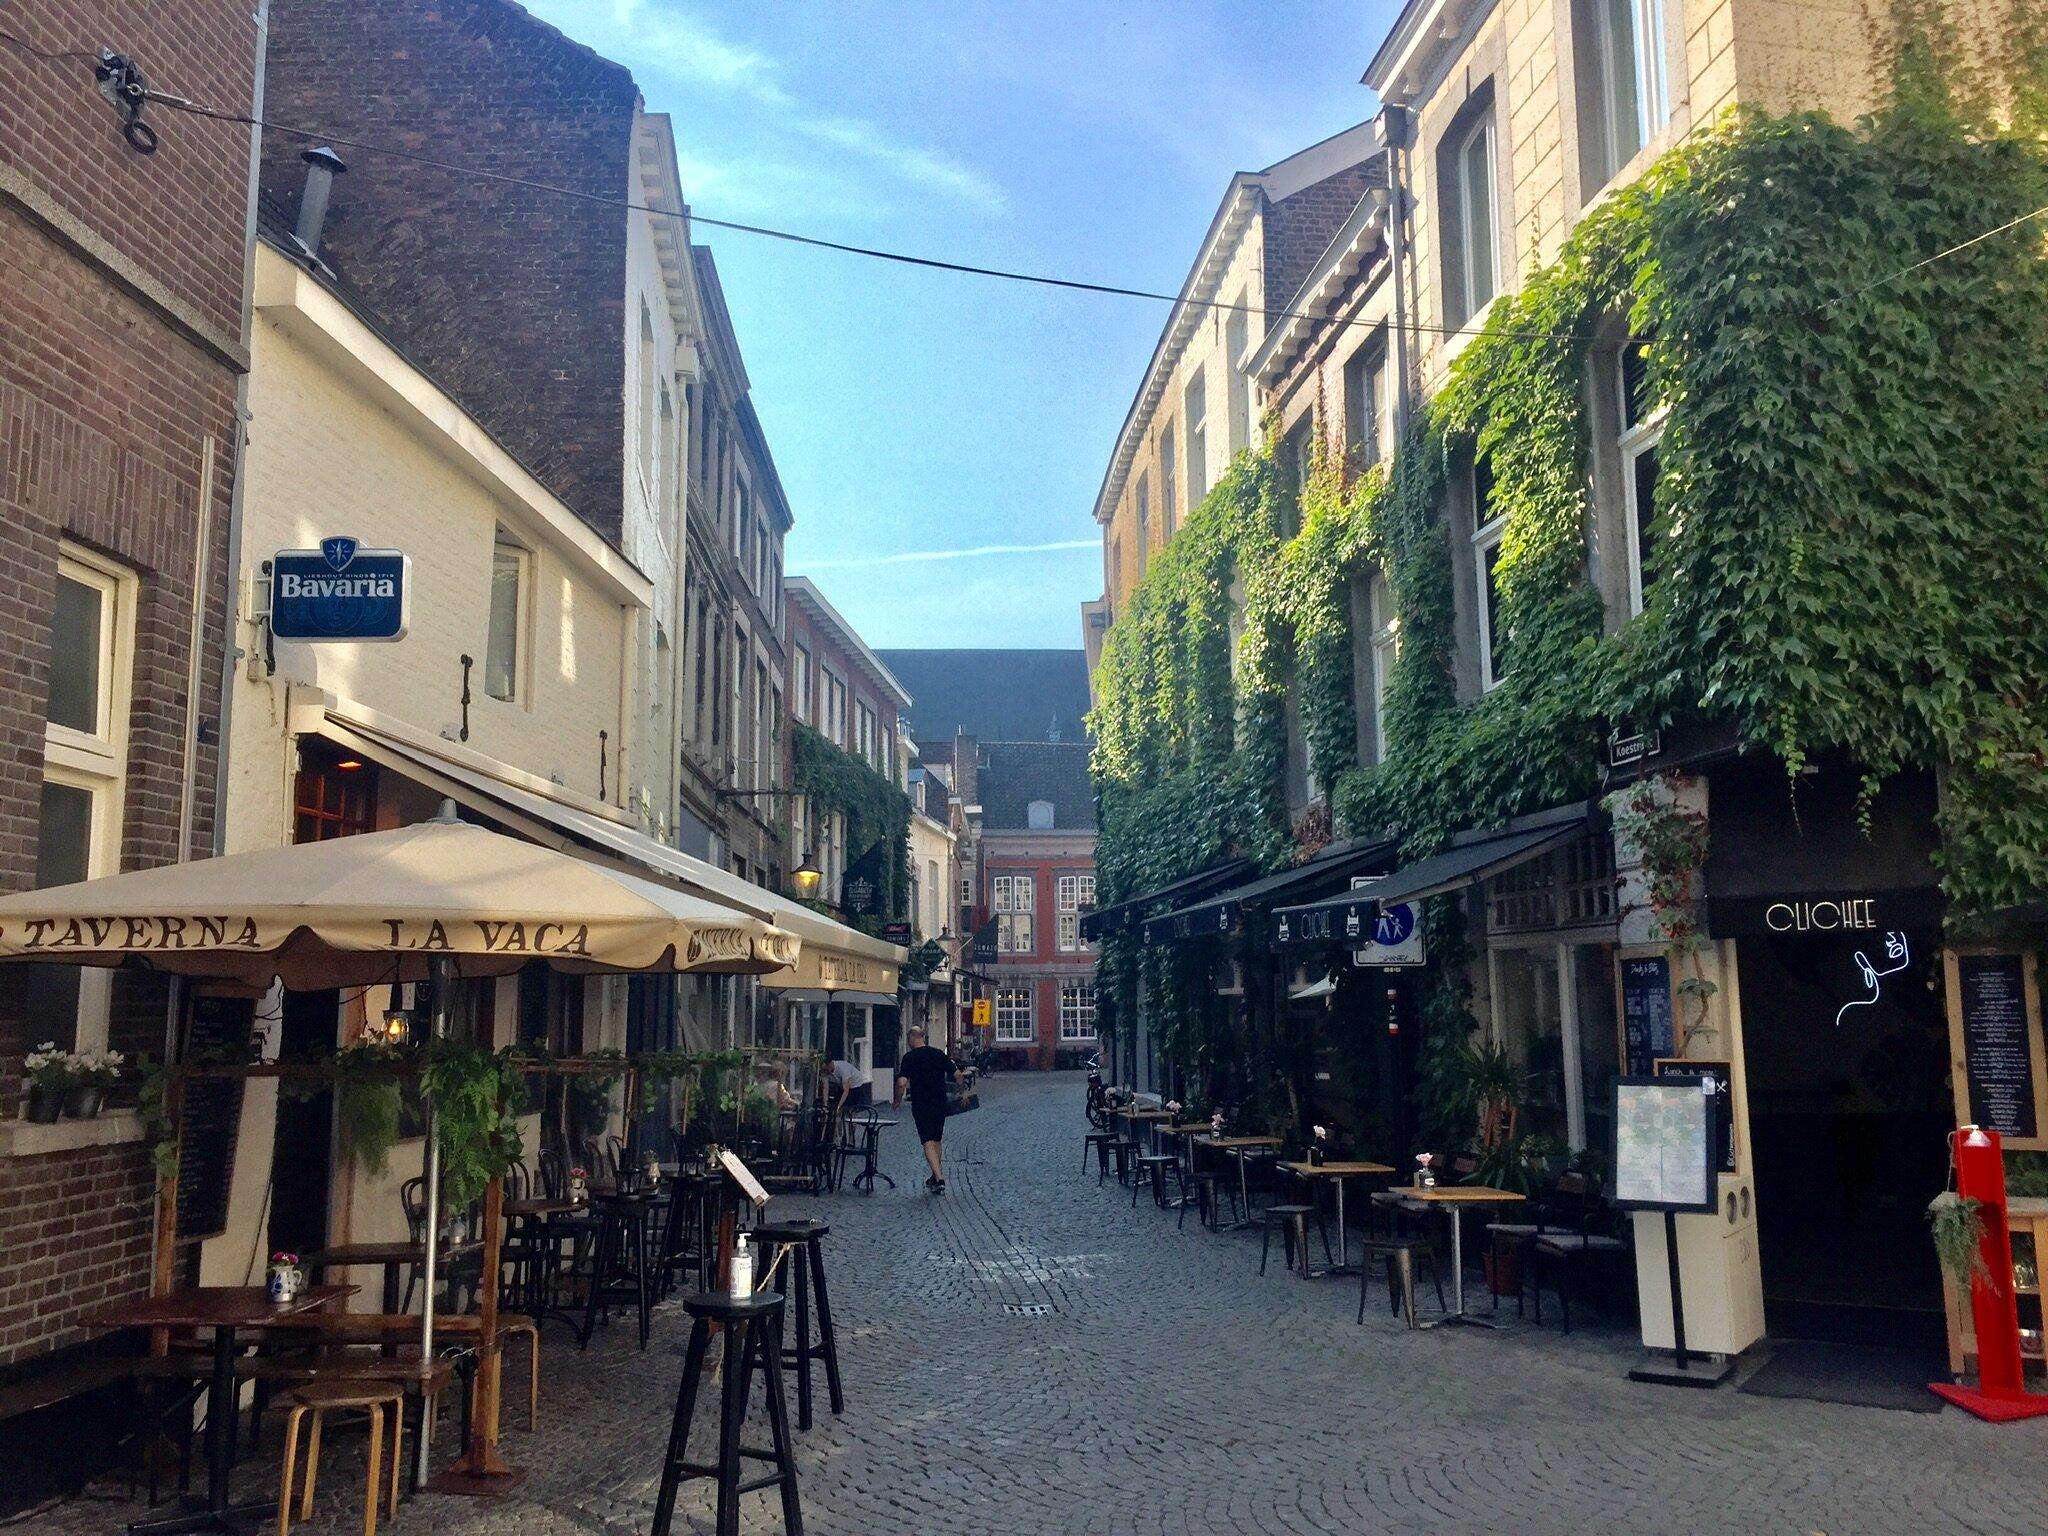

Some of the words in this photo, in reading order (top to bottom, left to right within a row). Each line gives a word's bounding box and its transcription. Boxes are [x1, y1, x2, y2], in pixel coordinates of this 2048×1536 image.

[280, 572, 395, 598] Bavaria
[1766, 899, 1877, 931] CLICHEE
[24, 916, 261, 949] TAVERNA
[382, 919, 455, 950] LA
[473, 920, 592, 957] VACA
